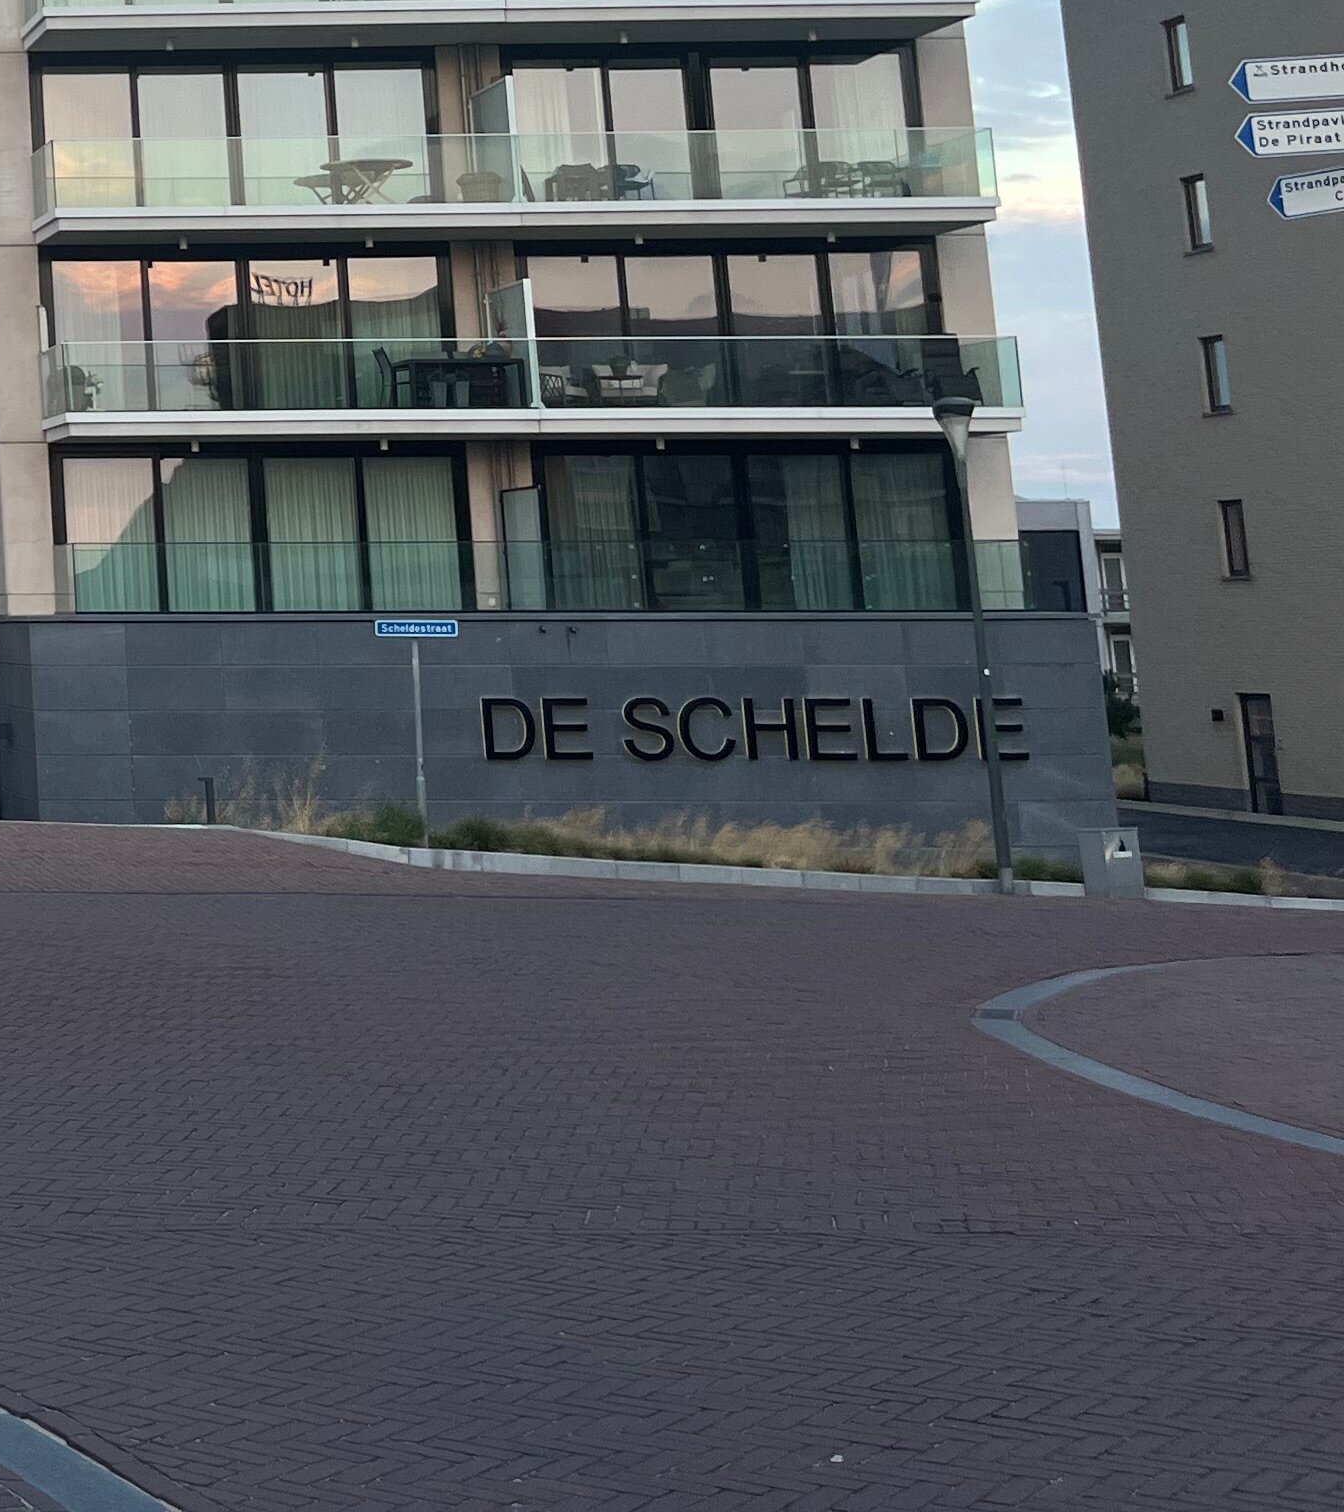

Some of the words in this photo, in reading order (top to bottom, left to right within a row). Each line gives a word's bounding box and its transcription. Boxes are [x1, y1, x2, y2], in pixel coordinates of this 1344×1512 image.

[1259, 137, 1279, 148] De
[1287, 132, 1342, 146] Piraat
[381, 623, 453, 633] Scheldestraat
[480, 697, 594, 761] DE
[621, 696, 1030, 762] SCHELDE
